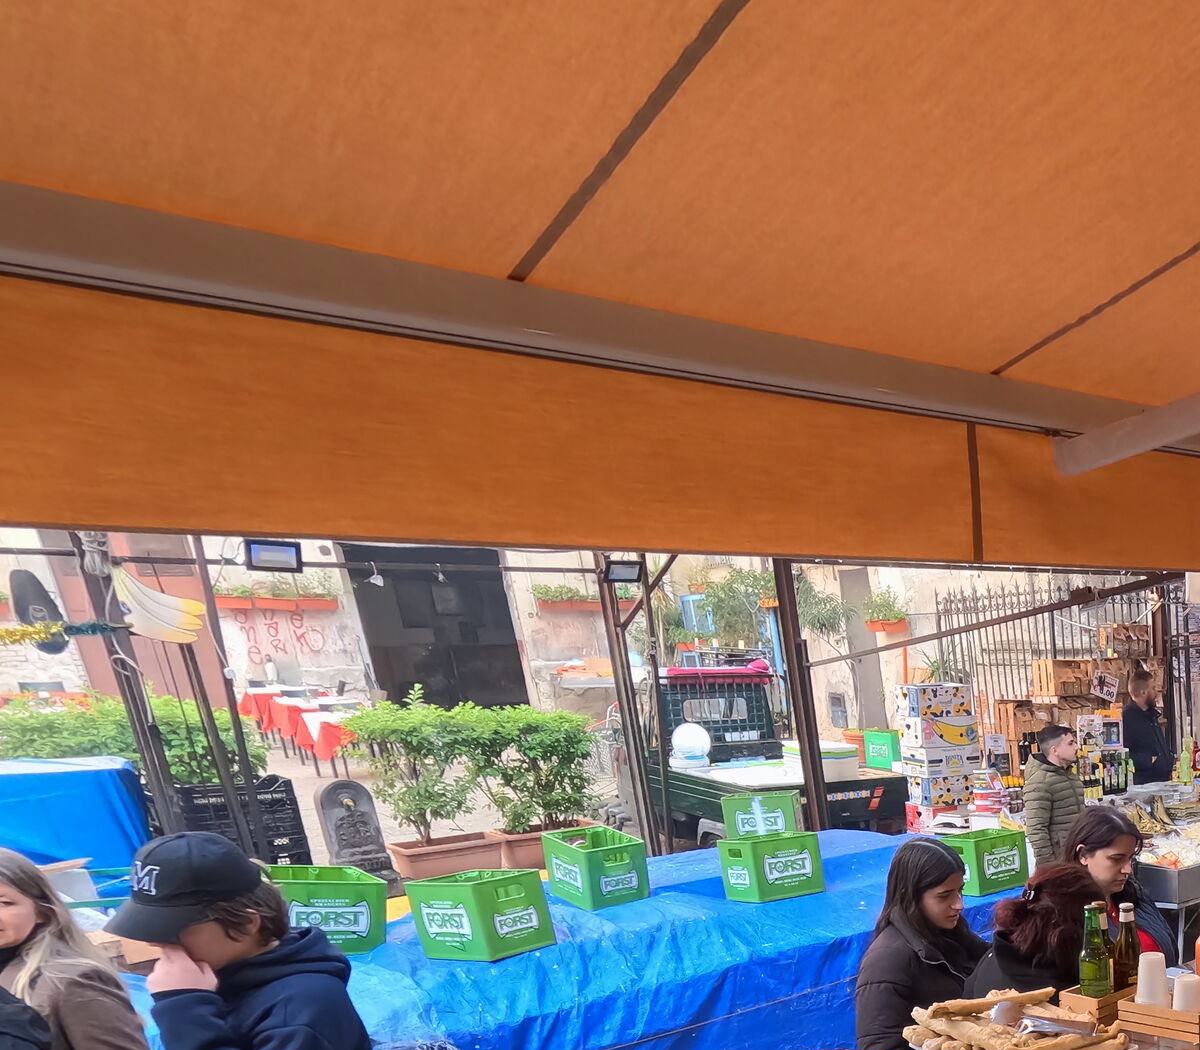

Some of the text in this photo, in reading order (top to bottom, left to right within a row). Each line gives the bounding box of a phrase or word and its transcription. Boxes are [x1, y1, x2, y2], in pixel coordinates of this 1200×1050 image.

[740, 815, 781, 829] FOST
[768, 856, 808, 876] FORST
[986, 853, 1017, 871] FORST
[133, 861, 160, 895] M
[604, 875, 636, 889] FORST
[294, 910, 365, 928] FORST
[425, 912, 465, 930] FORST
[498, 911, 534, 931] FORST
